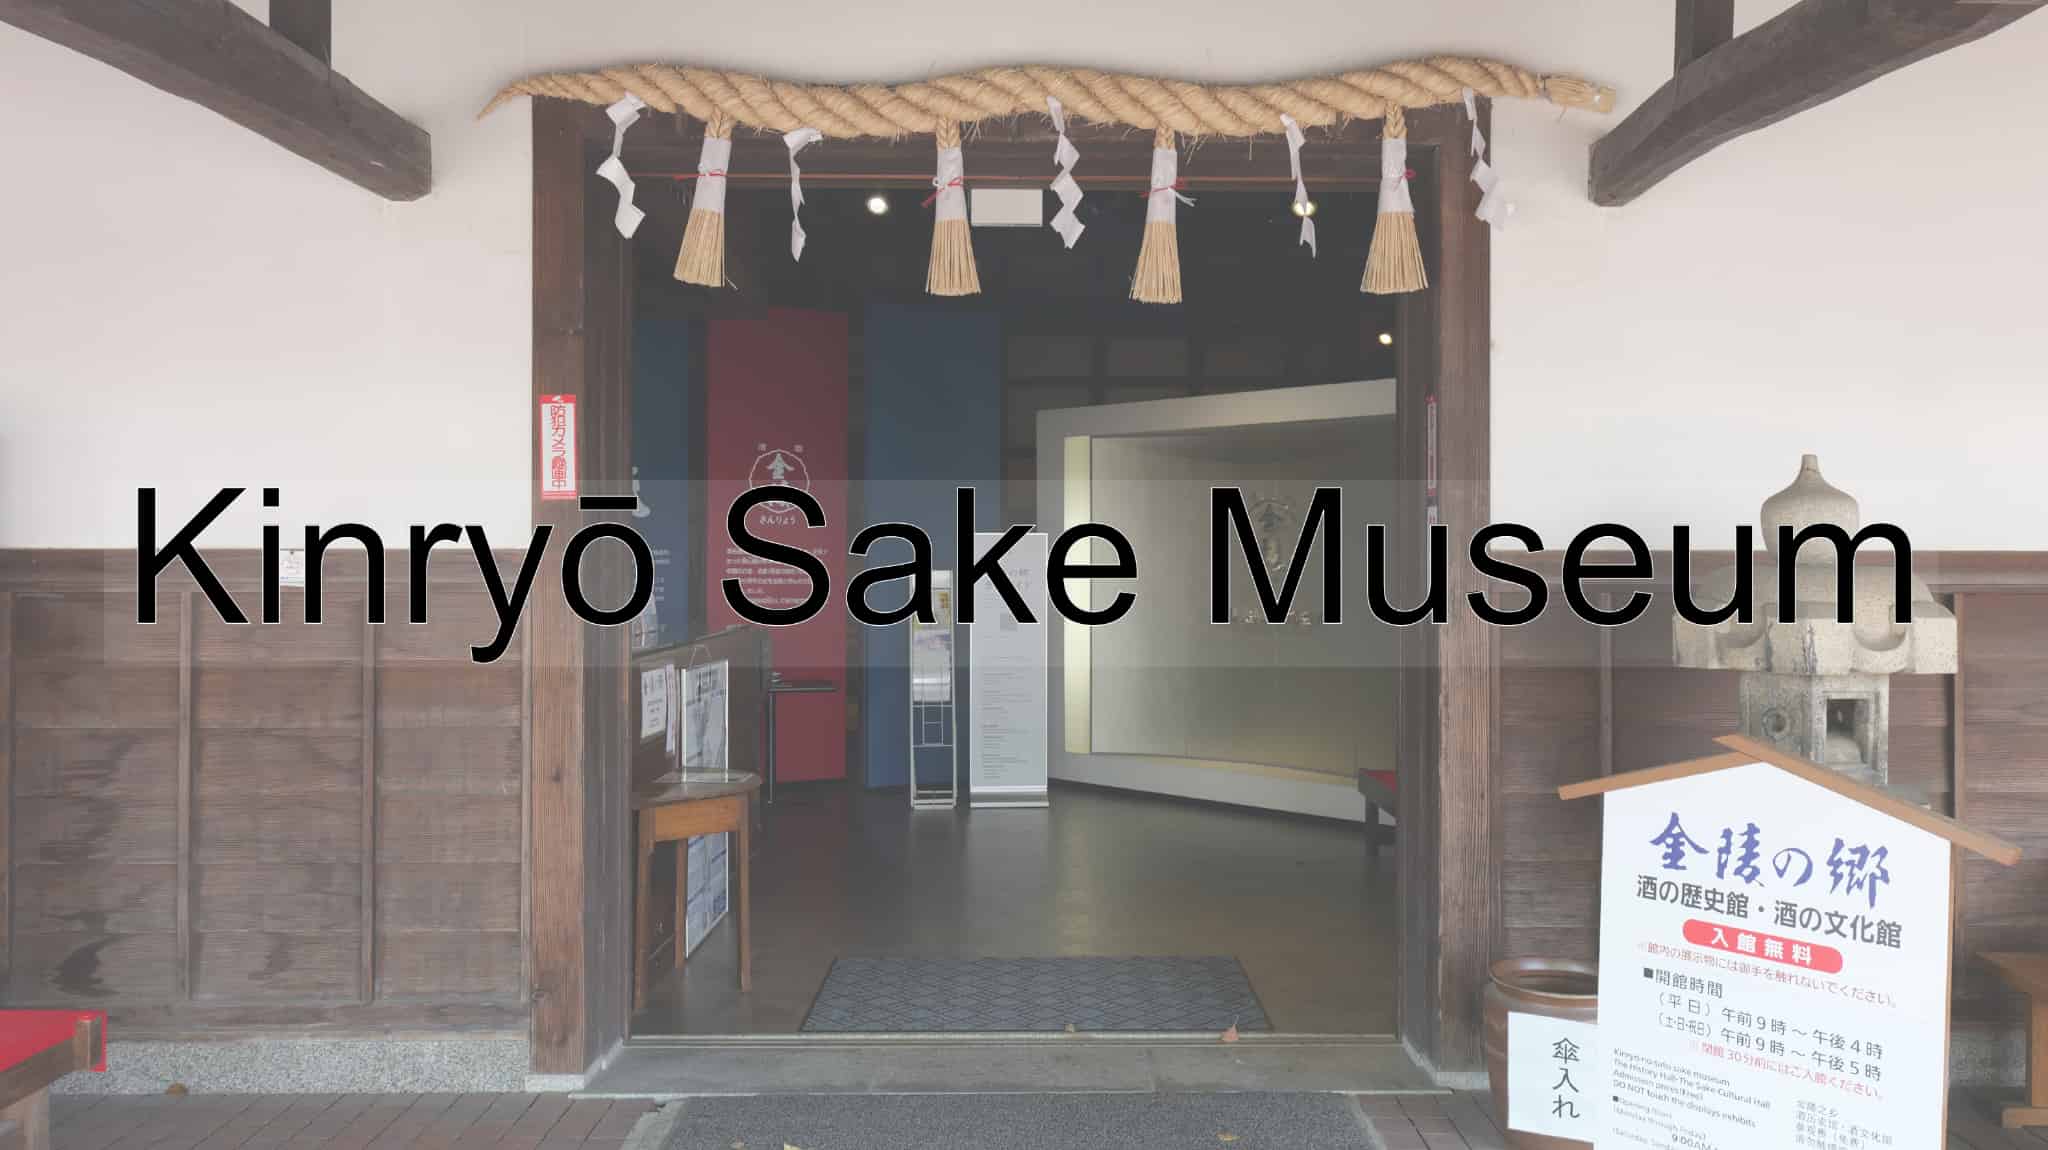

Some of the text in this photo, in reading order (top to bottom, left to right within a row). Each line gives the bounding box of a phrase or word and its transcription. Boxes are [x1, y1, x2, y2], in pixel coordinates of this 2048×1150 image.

[1635, 874, 1903, 949] 酒の歴史館・酒の文化館
[1710, 927, 1814, 966] 入館無料
[1552, 1037, 1581, 1119] 傘入れ
[1627, 1084, 1647, 1095] NOT
[1693, 1070, 1730, 1087] museum
